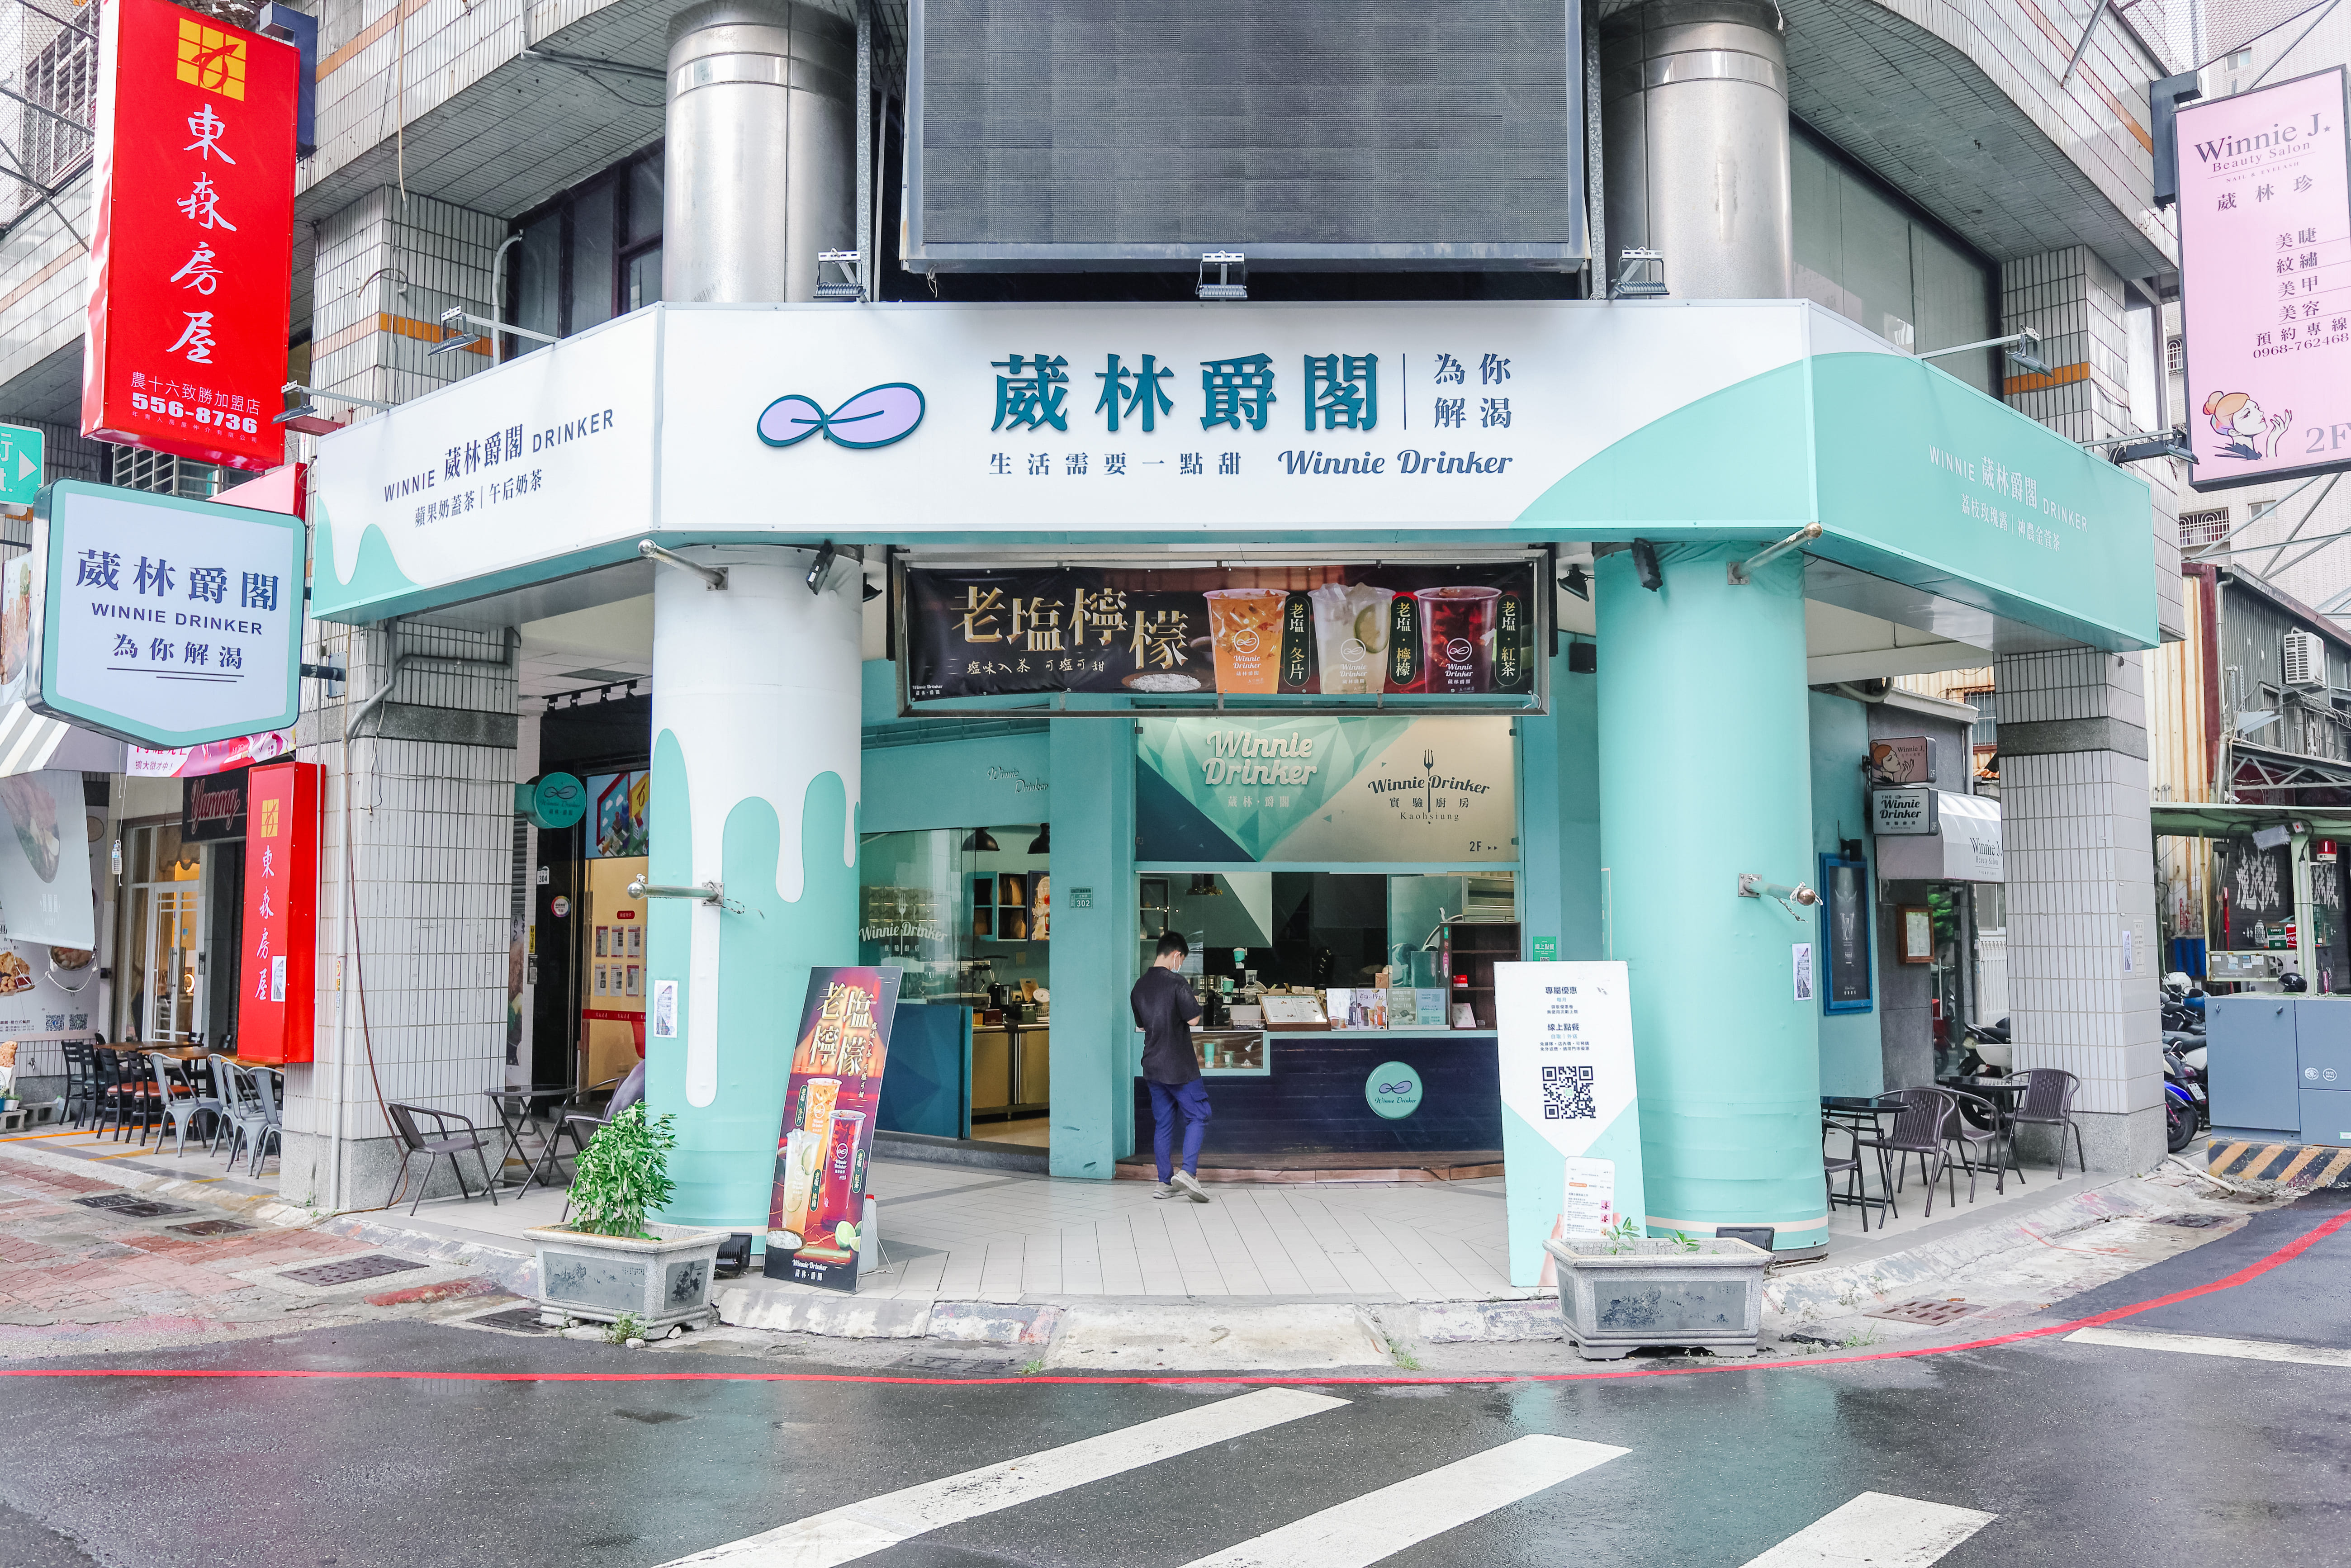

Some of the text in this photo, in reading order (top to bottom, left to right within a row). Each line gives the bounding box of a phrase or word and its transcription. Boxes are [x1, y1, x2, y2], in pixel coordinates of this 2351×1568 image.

[2194, 122, 2297, 163] Winnie
[2212, 142, 2310, 173] Beauty Salon
[2226, 175, 2246, 183] NAIL
[2261, 161, 2299, 175] EYELASH
[2217, 175, 2313, 212] 葳林珍
[166, 104, 236, 364] 東森房屋
[2276, 227, 2317, 249] 美睫
[2276, 251, 2318, 274] 紋繡
[2278, 275, 2319, 297] 美甲
[2279, 300, 2320, 322] 美容
[2256, 317, 2347, 346] 預約專線
[2253, 332, 2349, 359] 0968-762468
[1433, 353, 1511, 385] 為你
[131, 371, 261, 416] 農十六致勝加盟店
[990, 352, 1379, 433] 葳林爵閣
[132, 392, 257, 434] 556-8736
[1434, 397, 1512, 429] 解渴
[2306, 423, 2351, 454] 2F
[384, 409, 613, 502] WINNIE 葳林爵閣 DRINKER
[989, 449, 1513, 475] 生活需要一點甜 Winnie Drinker
[414, 469, 543, 529] 蘋果奶蓋茶 午后奶茶
[1929, 444, 2088, 533] WINNIE 葳林爵閣 DRINKER
[1961, 493, 2061, 552] 荔枝玫瑰露 神農金萱茶
[76, 549, 279, 611] 葳林爵閣
[91, 602, 263, 635] WINNIE DRINKER
[950, 586, 1189, 670] 老塩檸檬
[113, 633, 243, 670] 為你解渴
[1205, 730, 1313, 760] Winnie
[987, 766, 1019, 780] Winnie
[1015, 777, 1048, 794] Drinker
[1202, 758, 1318, 786] Drinker
[1367, 775, 1490, 794] Winnie Drinker
[1930, 769, 1935, 777] 2F
[190, 778, 241, 835] Yummy
[1389, 797, 1469, 808] 實驗廚房
[1880, 809, 1922, 819] Drinker
[1881, 799, 1920, 809] Winnie
[1400, 812, 1460, 822] Kaohsiung
[1932, 822, 1937, 830] 2F
[1469, 841, 1482, 852] 2F
[1969, 838, 1996, 856] Winnie
[1976, 855, 1998, 866] Beauty Salon
[255, 845, 275, 1000] 東森房屋
[859, 921, 948, 943] Winnie Drinker
[1545, 986, 1578, 995] 專屬優惠
[1547, 1023, 1580, 1031] 線上點餐
[792, 1259, 829, 1271] Winnie Drinker
